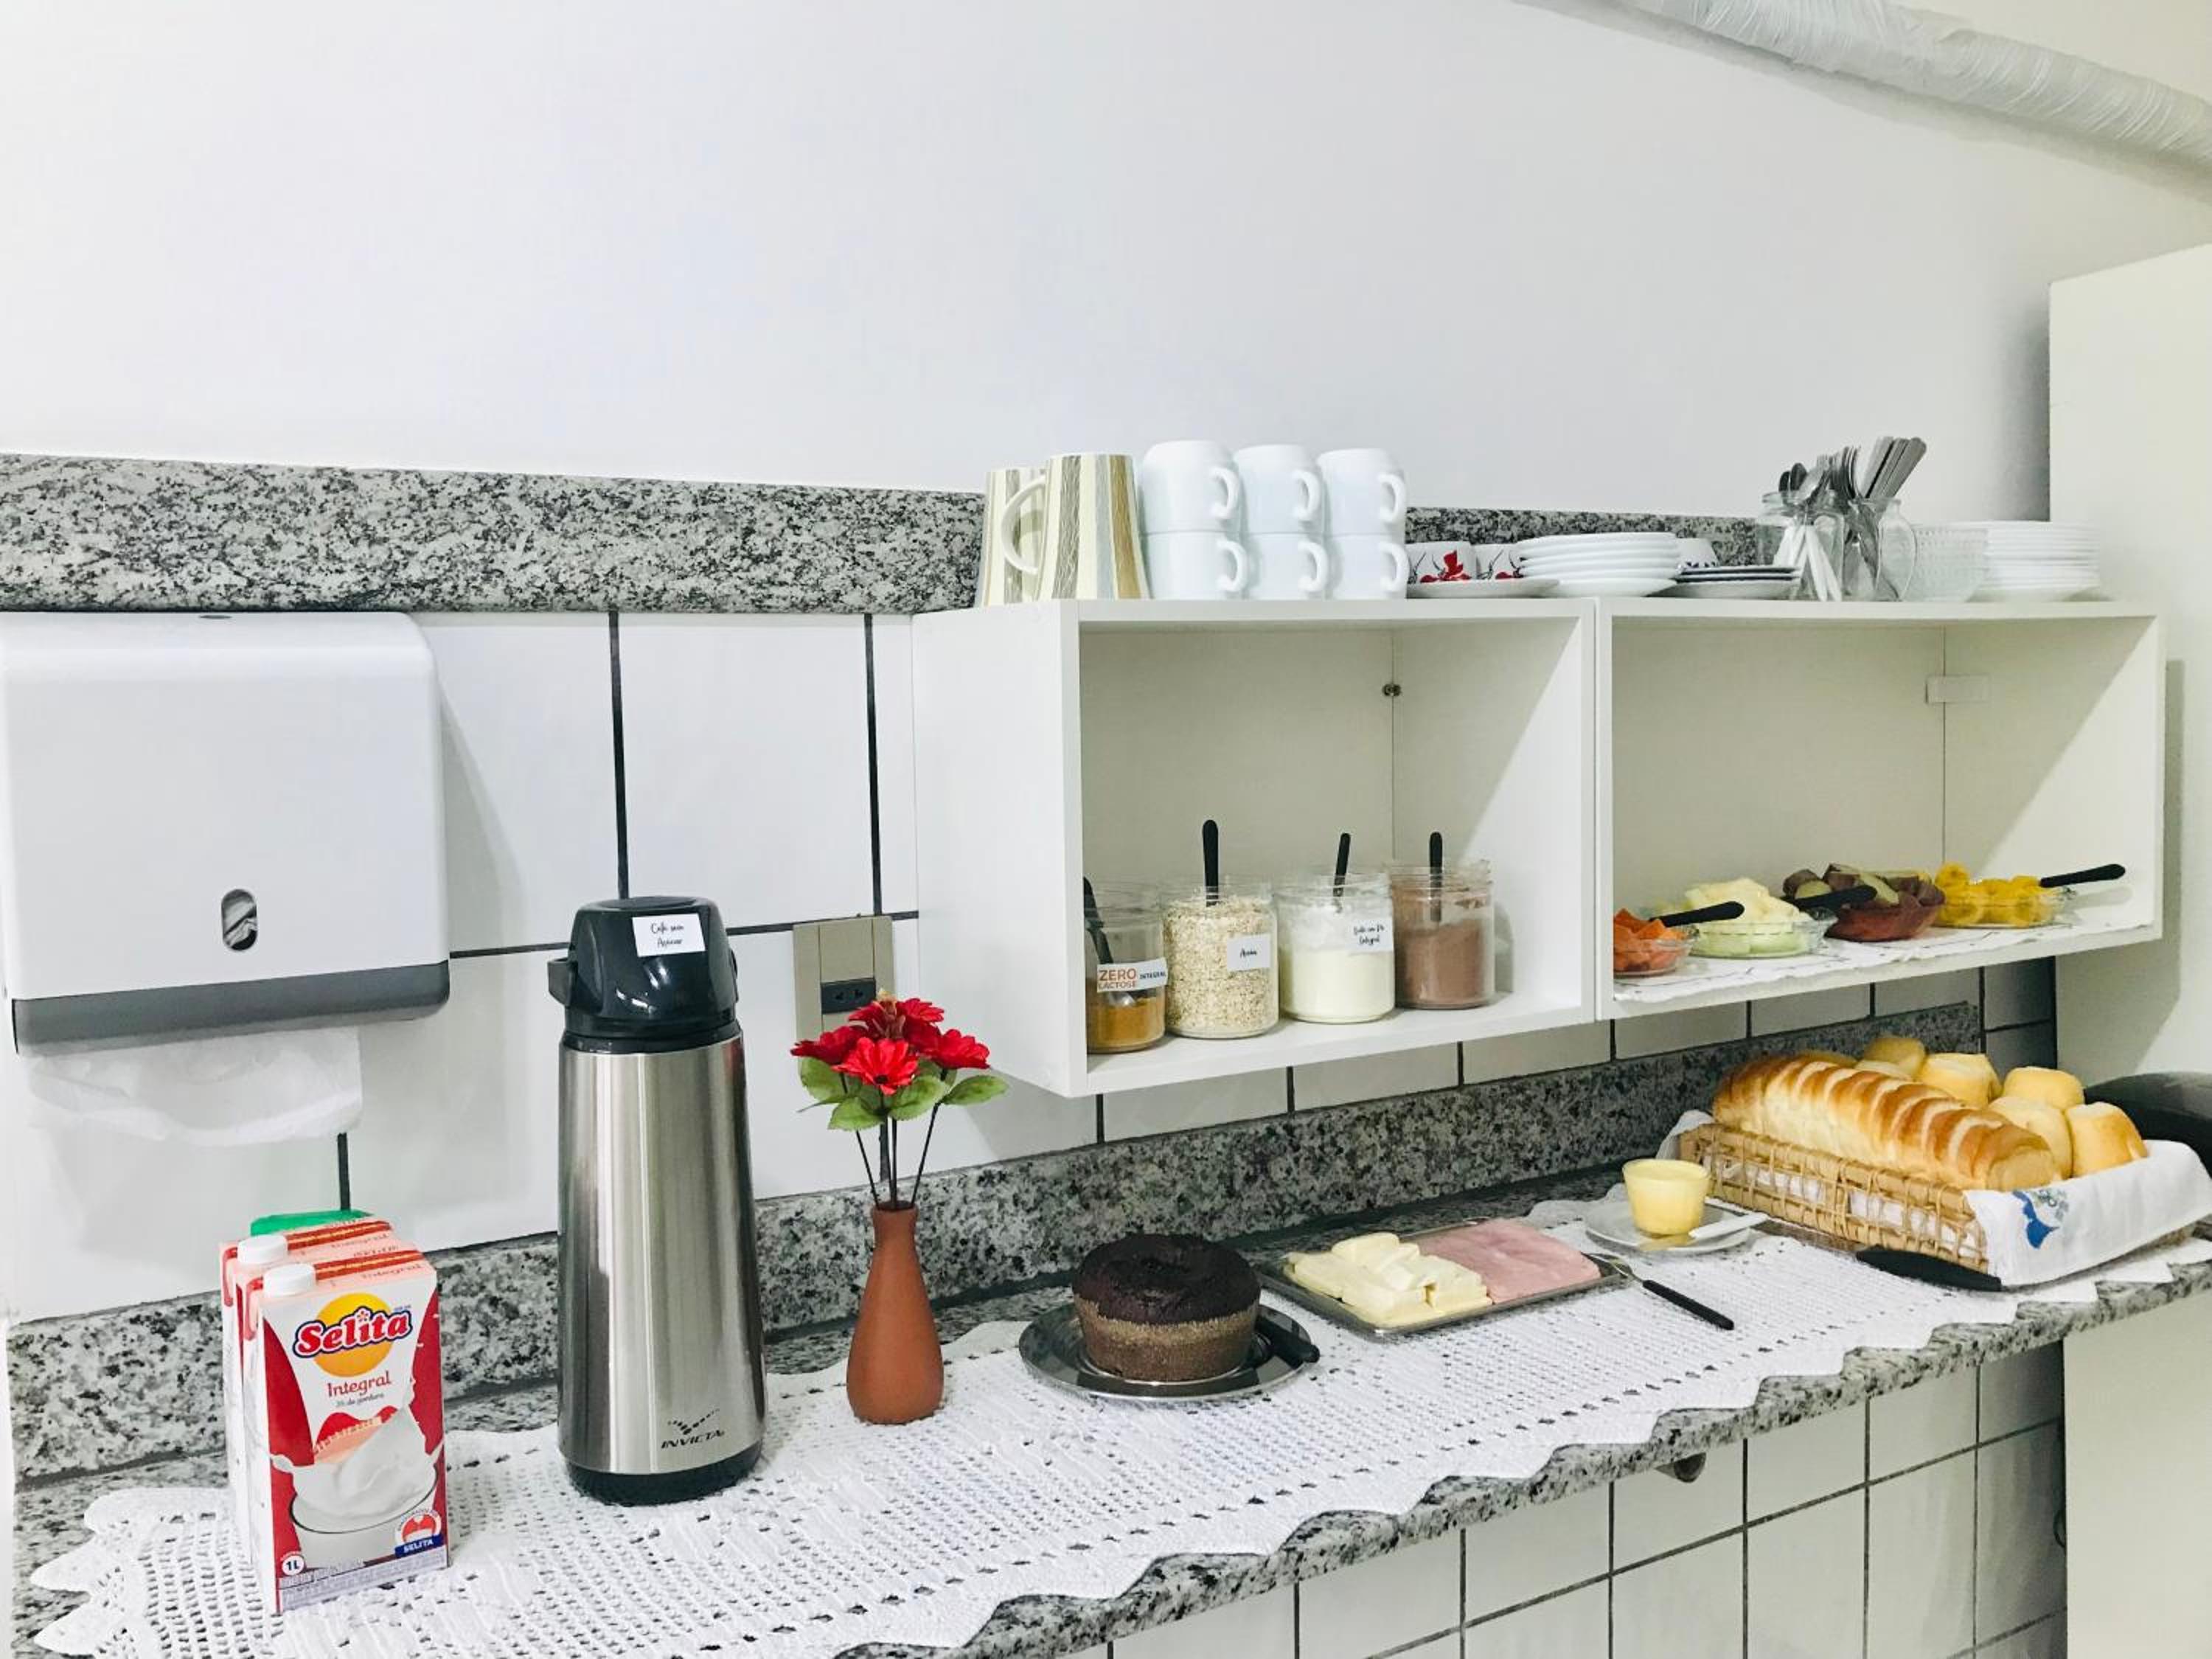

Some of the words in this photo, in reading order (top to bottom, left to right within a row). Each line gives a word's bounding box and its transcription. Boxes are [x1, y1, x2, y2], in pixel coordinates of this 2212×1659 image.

[1099, 967, 1137, 981] ZERO
[293, 1305, 413, 1358] Selita
[327, 1371, 391, 1397] Integral
[403, 1539, 434, 1554] SELITA
